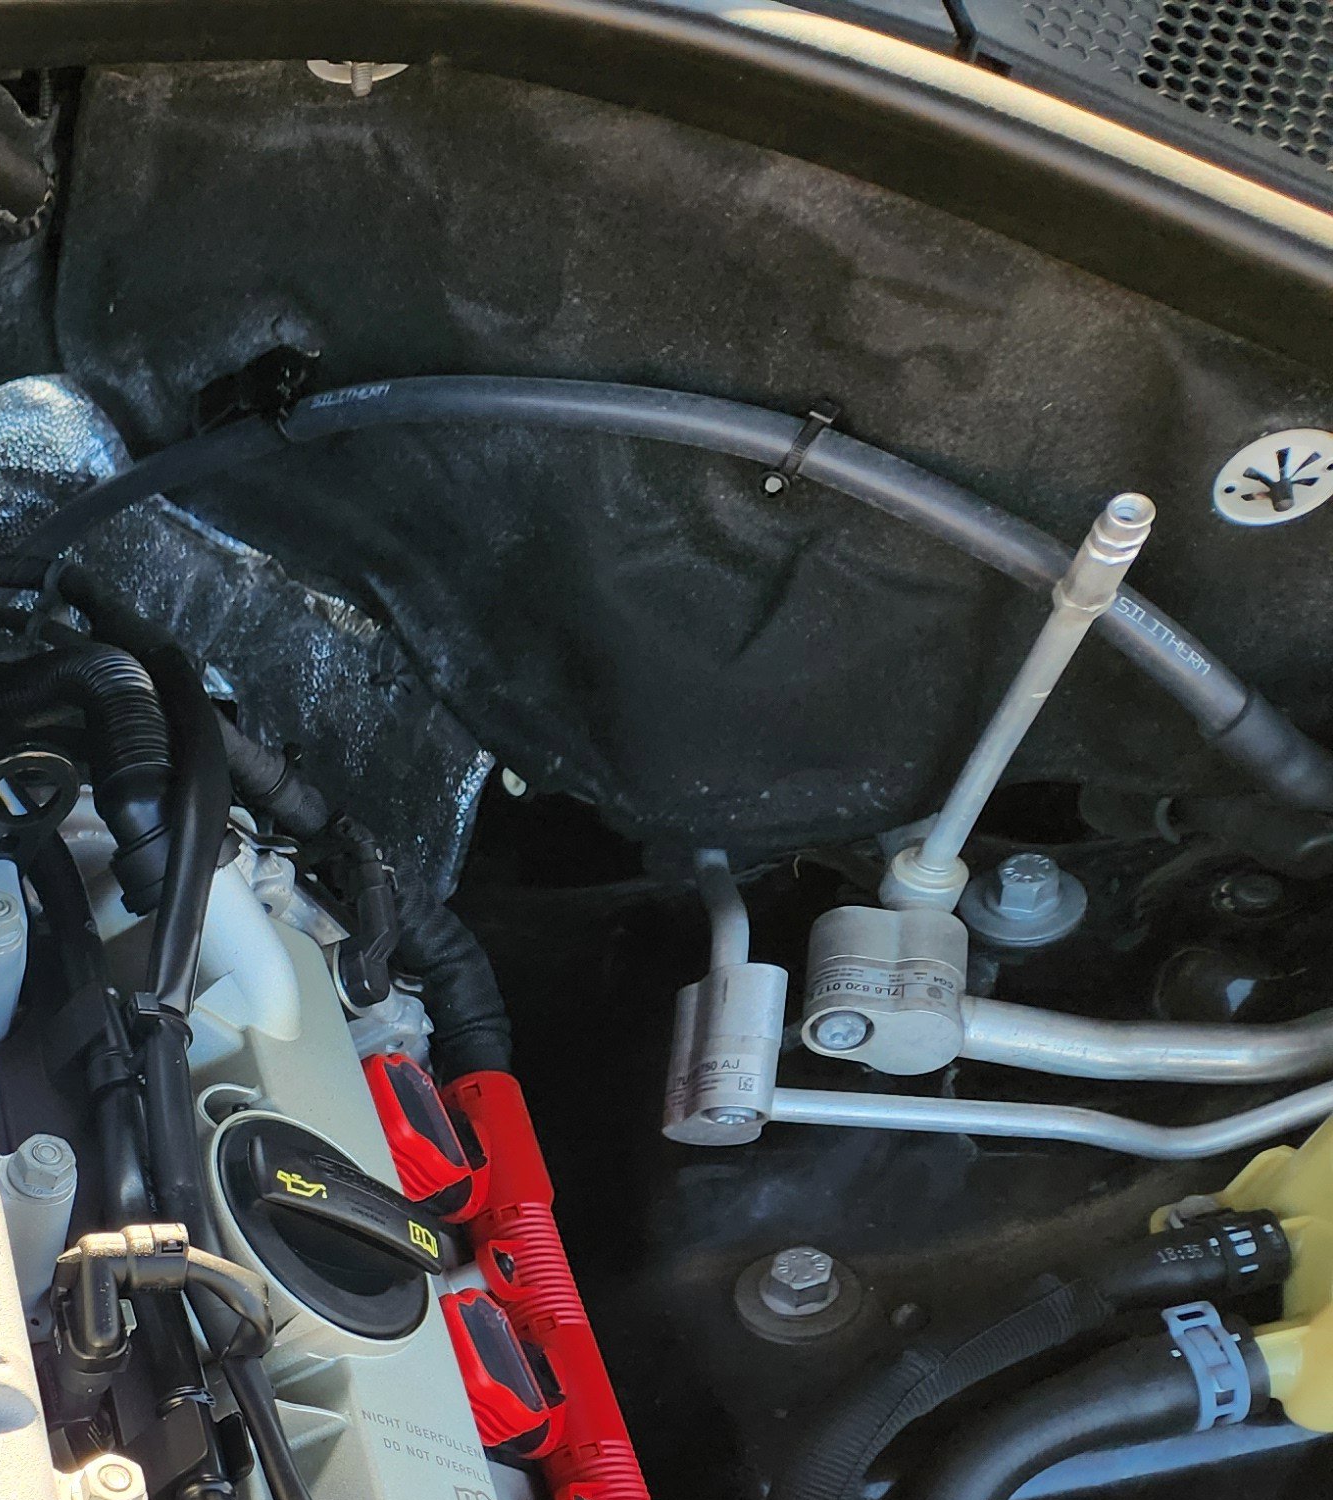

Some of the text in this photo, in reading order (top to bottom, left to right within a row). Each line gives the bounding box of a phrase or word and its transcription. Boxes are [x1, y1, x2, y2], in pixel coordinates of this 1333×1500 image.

[1115, 596, 1211, 676] SILITHERM
[361, 1409, 400, 1429] NICHT
[383, 1437, 490, 1485] DO NOT OVERFILL
